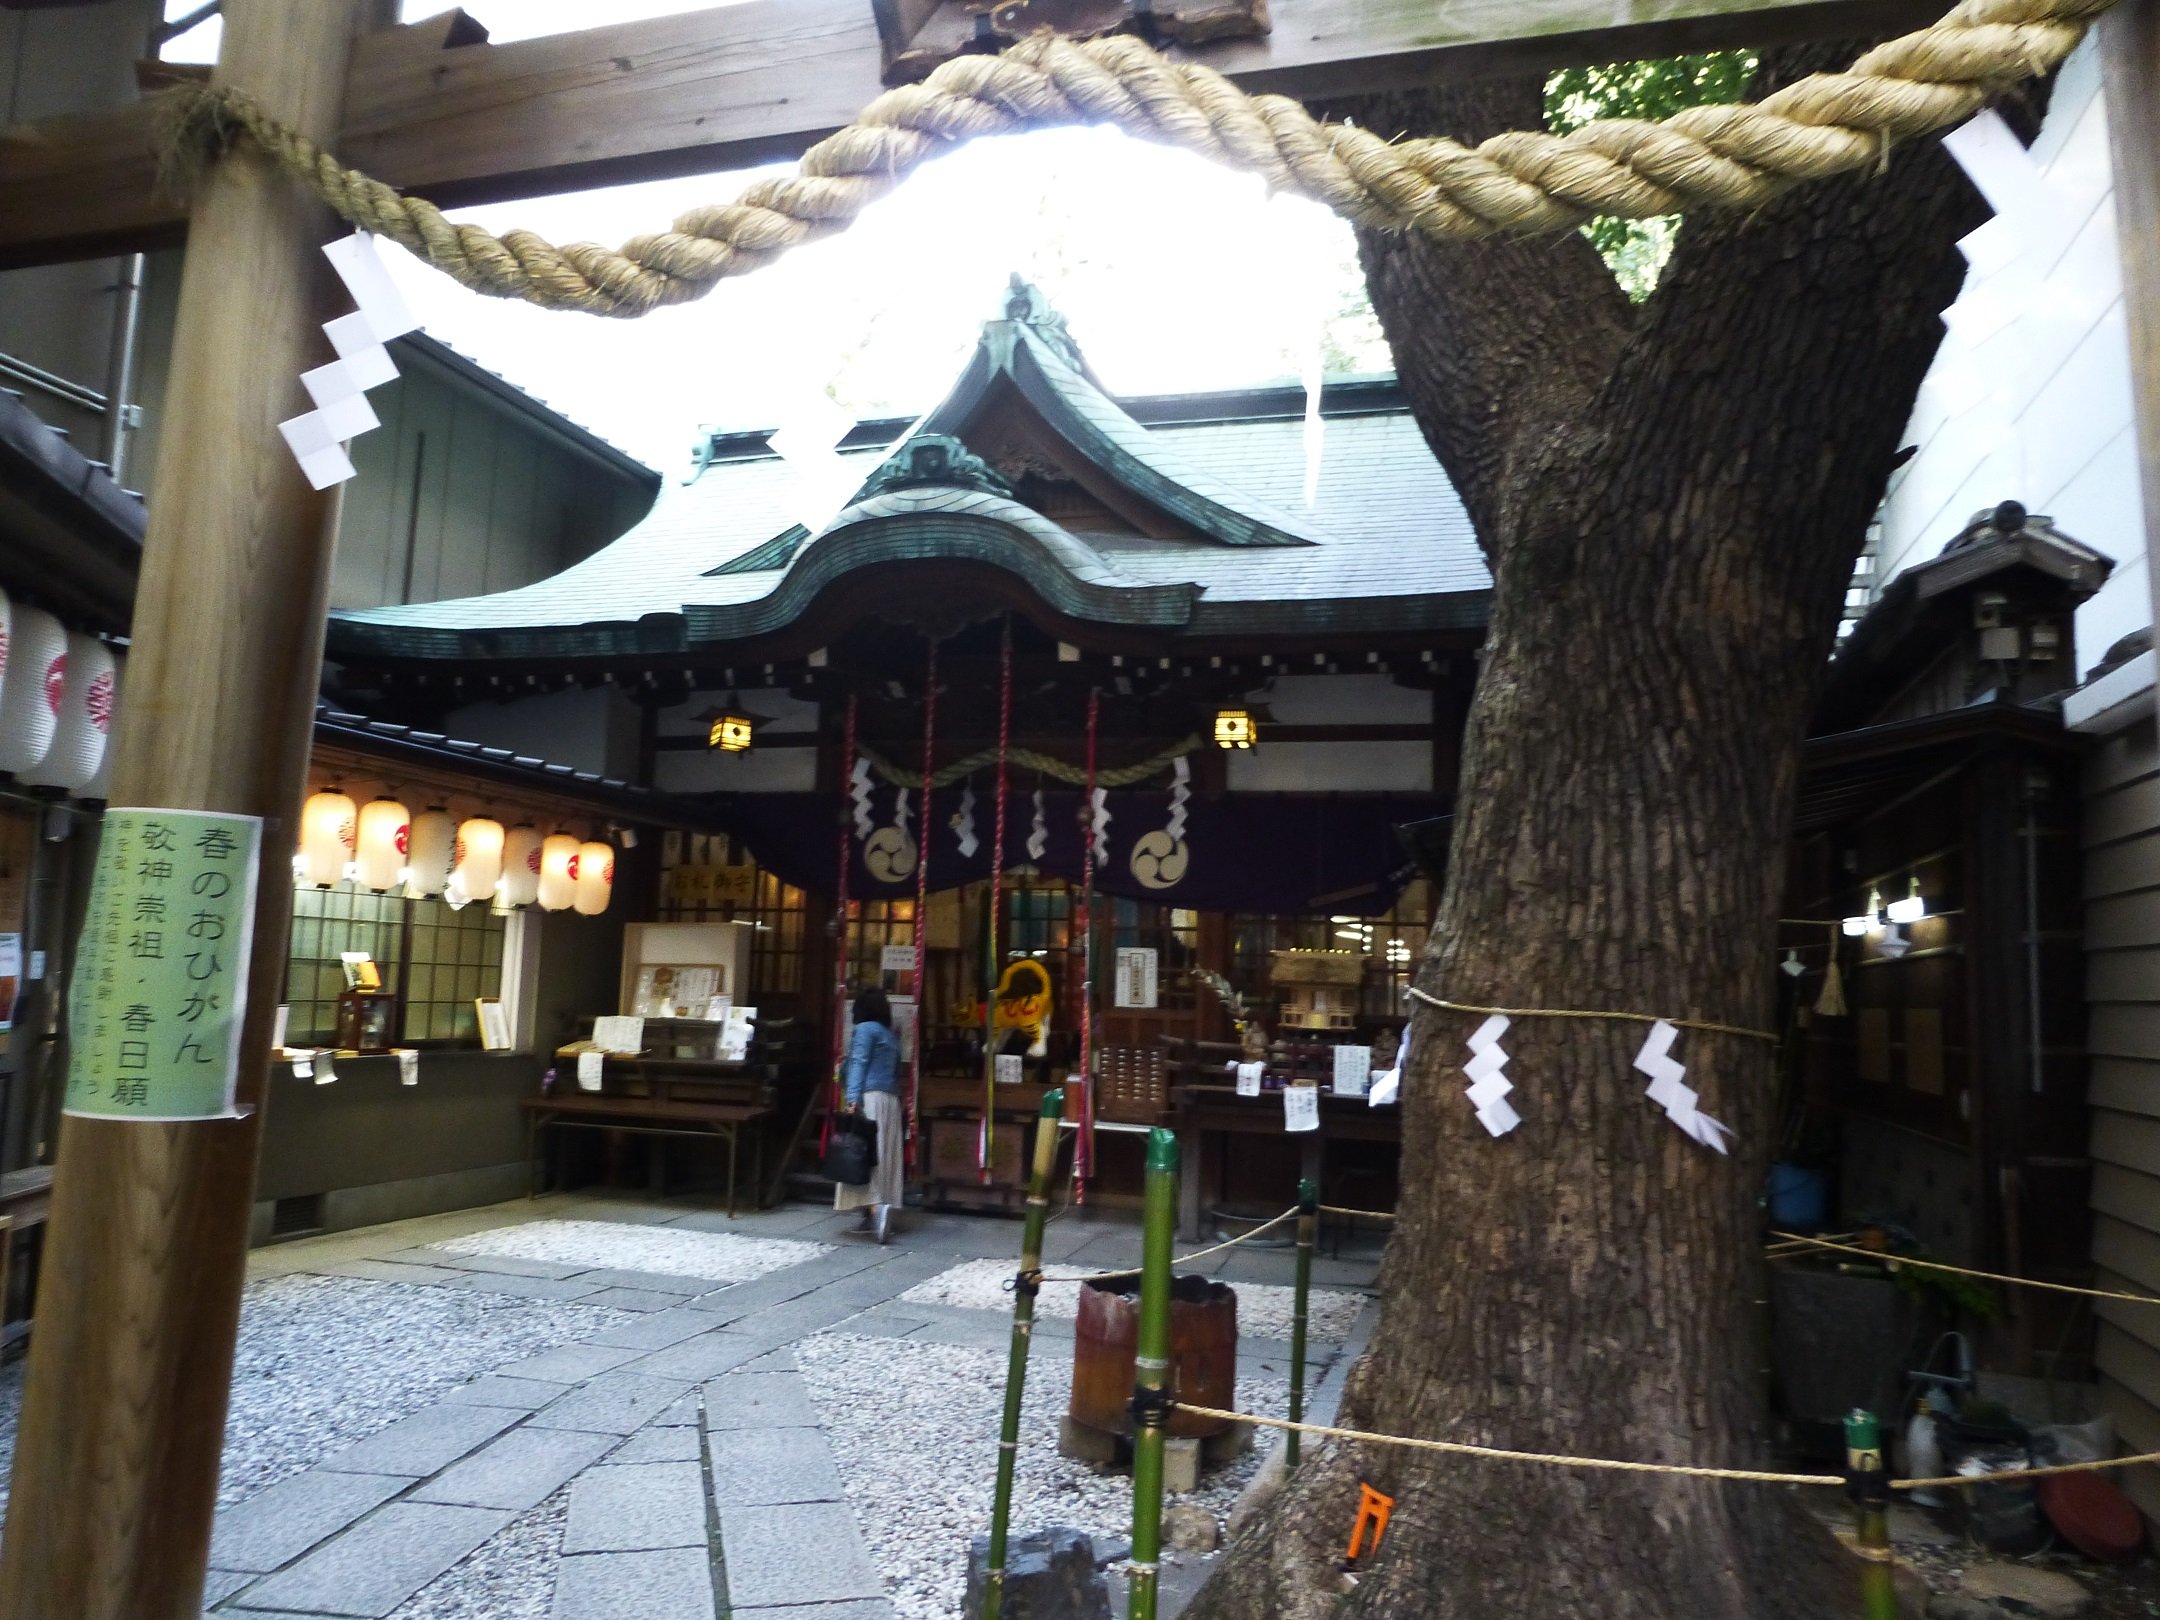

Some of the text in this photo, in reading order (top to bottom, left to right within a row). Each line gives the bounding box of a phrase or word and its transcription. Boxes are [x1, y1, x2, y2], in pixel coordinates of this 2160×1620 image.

[173, 828, 238, 1064] 春のおひがん
